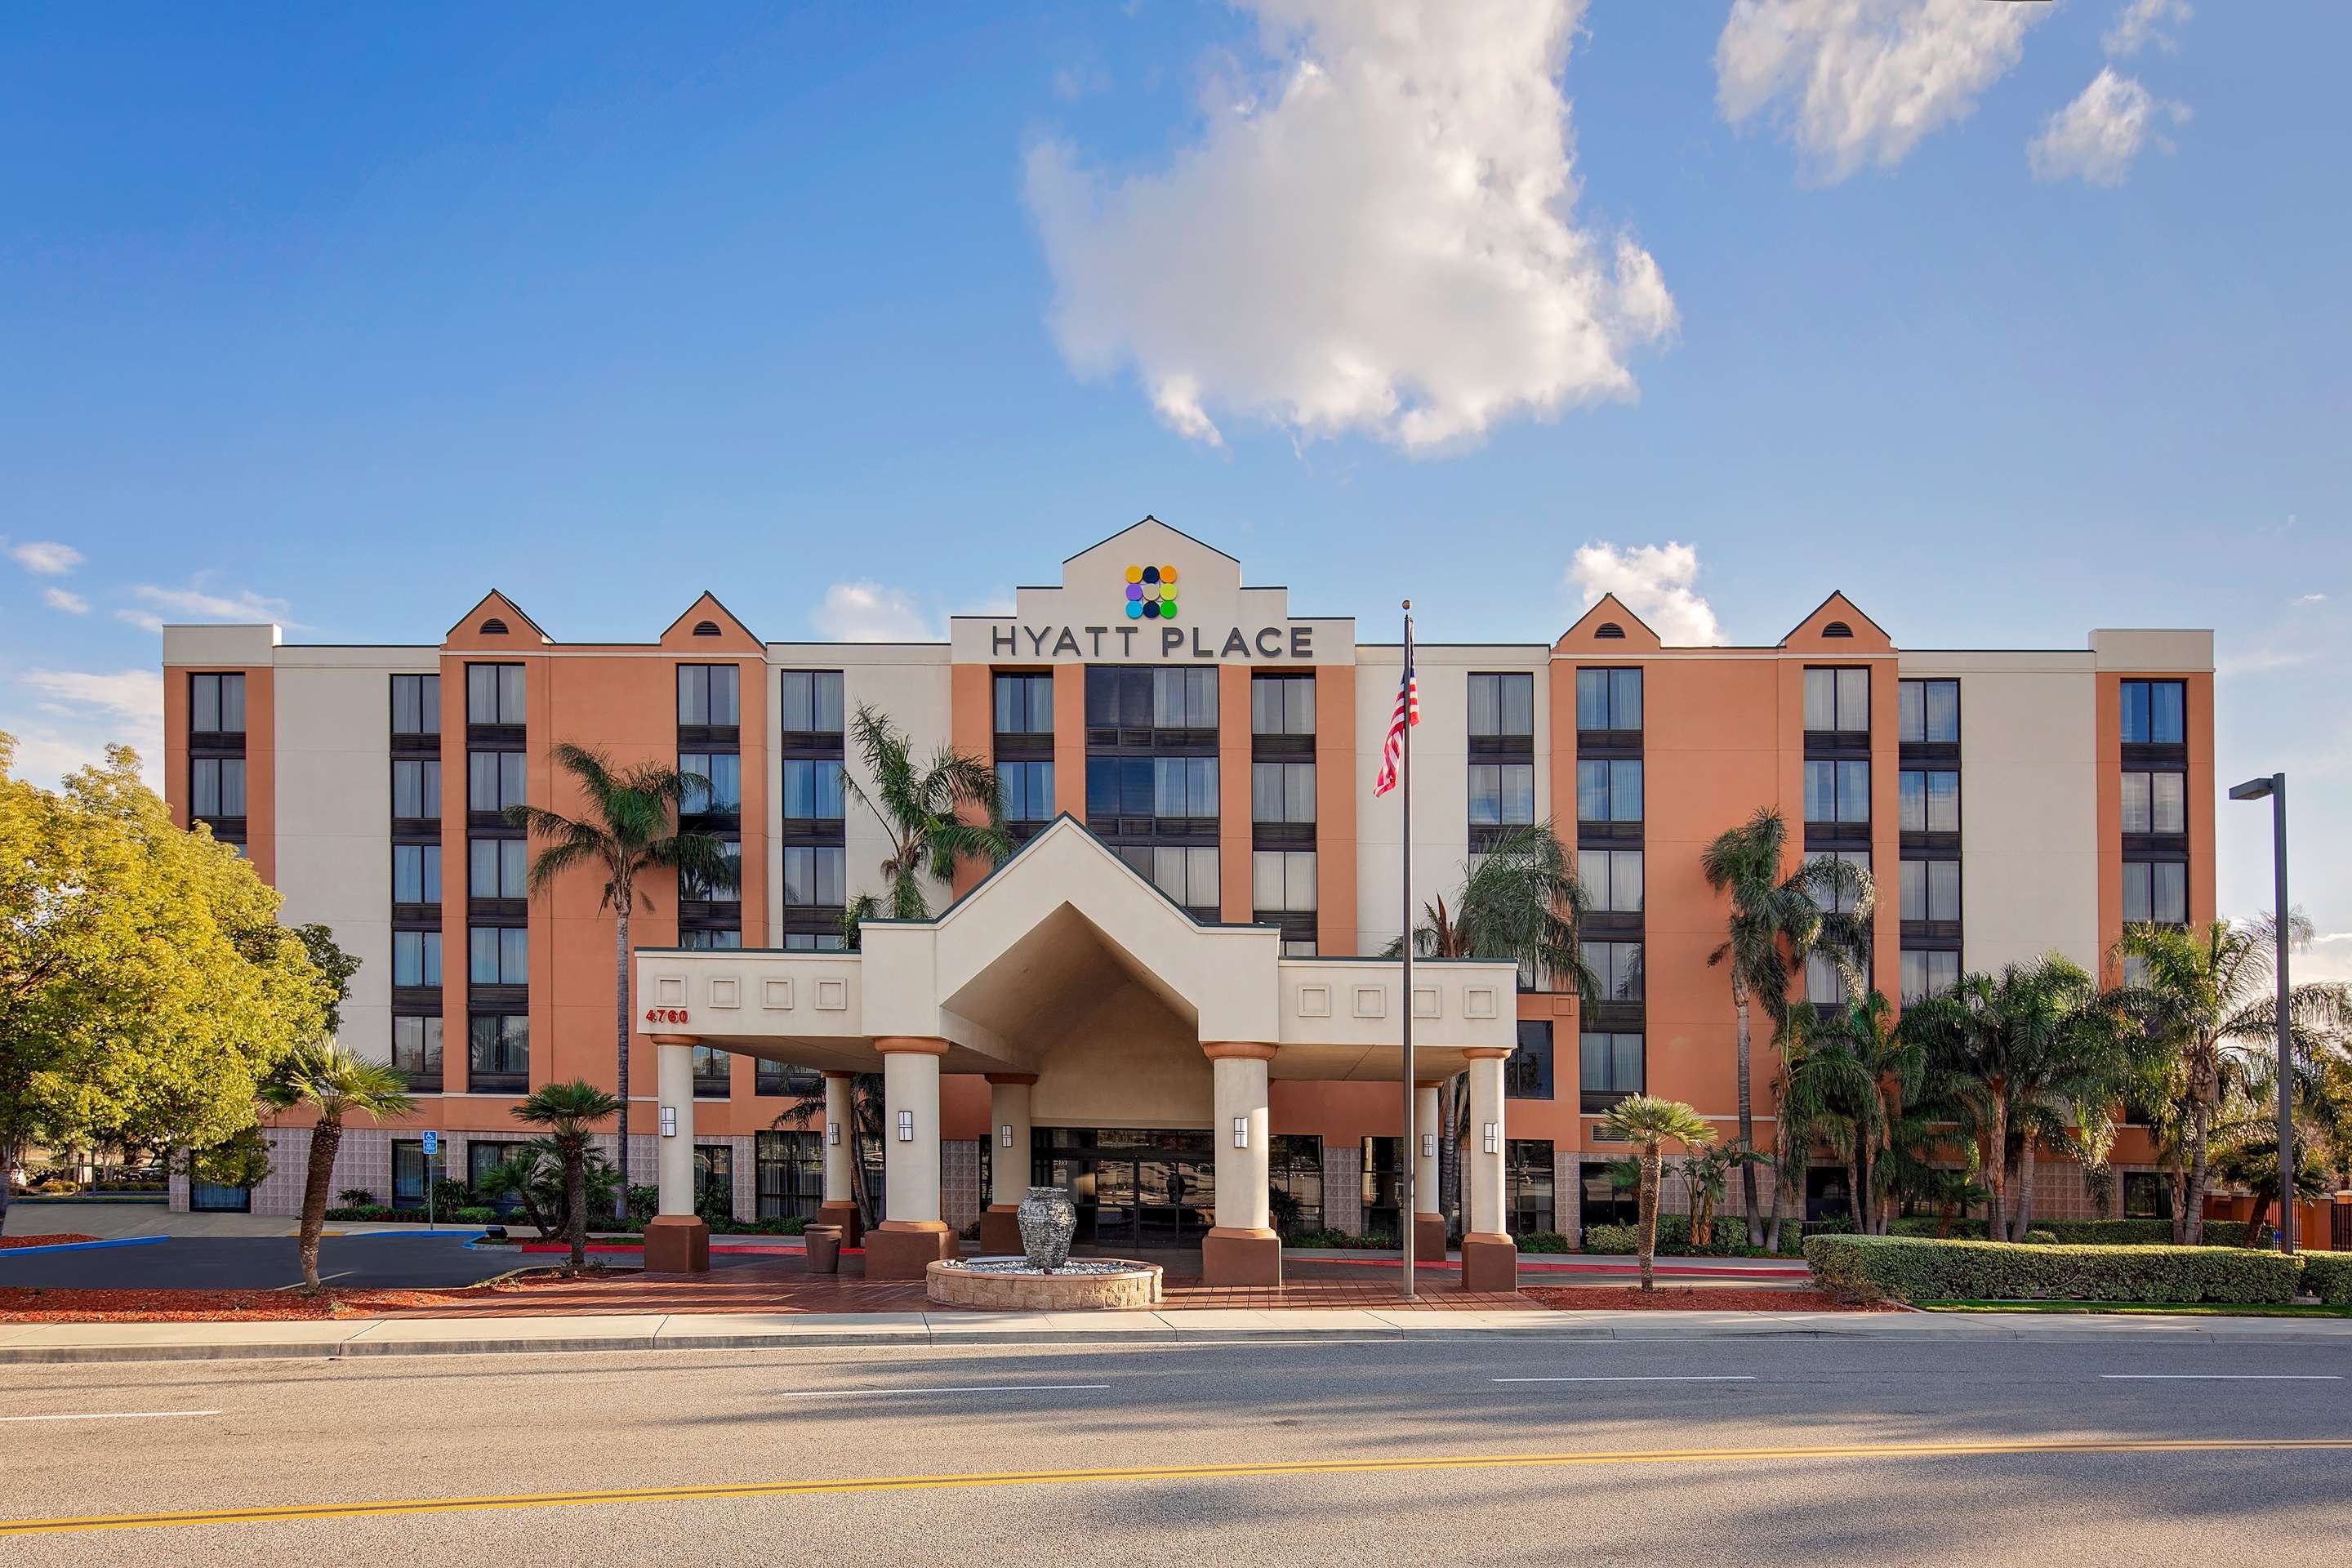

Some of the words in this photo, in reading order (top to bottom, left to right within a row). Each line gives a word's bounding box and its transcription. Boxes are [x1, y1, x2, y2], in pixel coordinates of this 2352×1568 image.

[992, 626, 1138, 657] HYATT
[1162, 626, 1313, 658] PLACE
[645, 1009, 689, 1023] 4760
